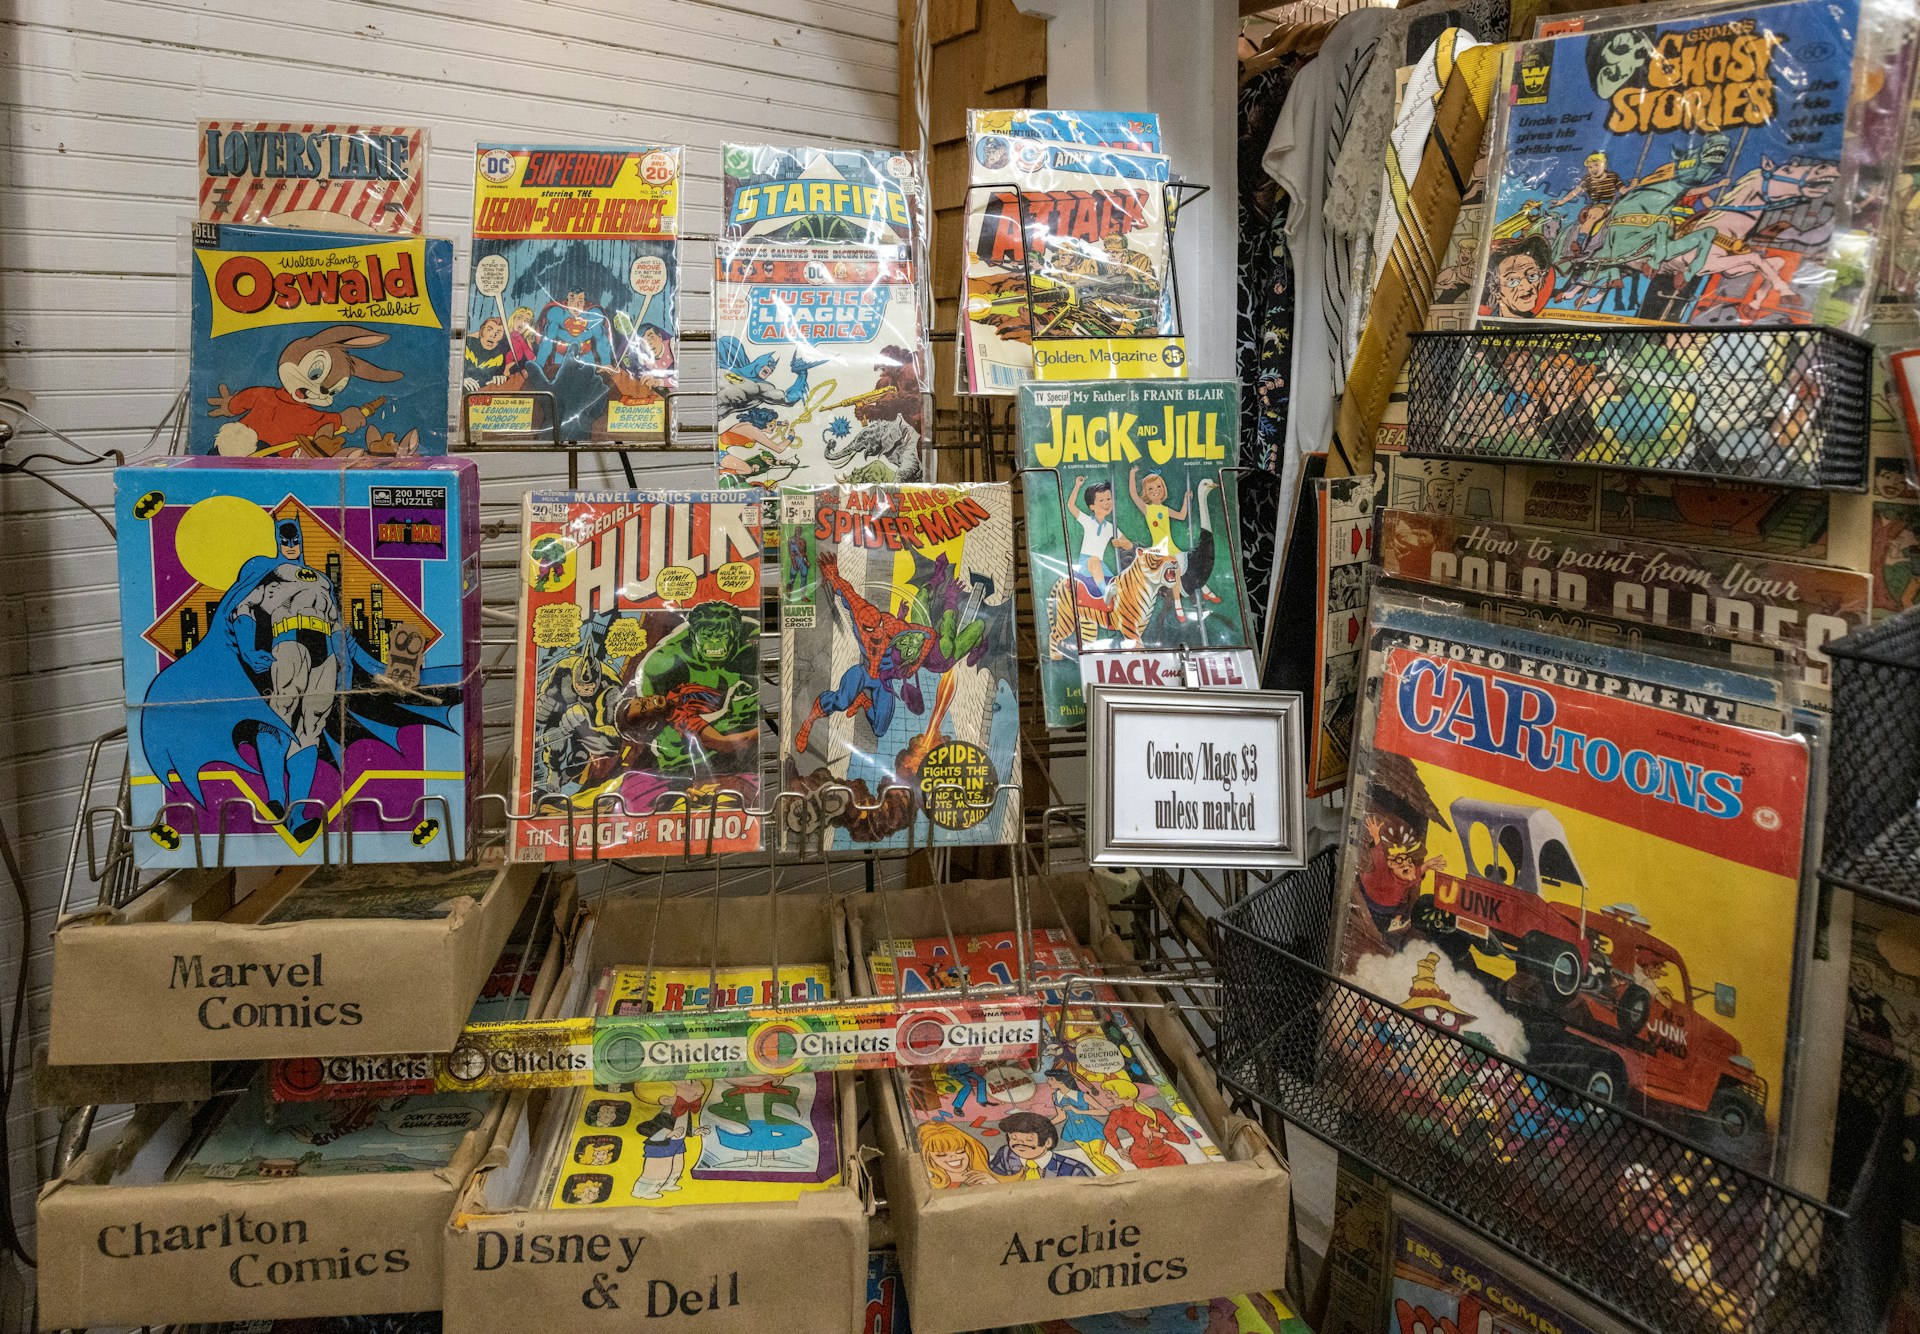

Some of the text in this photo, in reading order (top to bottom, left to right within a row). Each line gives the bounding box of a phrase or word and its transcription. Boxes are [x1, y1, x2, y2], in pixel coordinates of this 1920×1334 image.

[1648, 34, 1783, 88] GHOST
[1608, 80, 1774, 133] STORIES
[1518, 111, 1593, 127] Uncle Bert
[1516, 127, 1577, 144] gives his
[206, 129, 409, 180] LOVERS' LANE
[487, 157, 510, 174] DC
[523, 152, 625, 186] SUPERBOY
[541, 189, 593, 200] starring THE
[735, 182, 910, 225] STARFIRE
[476, 197, 538, 232] LEGION
[542, 199, 668, 233] SUPER-HEROES
[980, 189, 1149, 267] ATTACK
[277, 253, 361, 269] Walter Lantz
[771, 248, 829, 259] SALUTES THE
[214, 252, 419, 314] Oswald
[760, 289, 877, 305] JUSTICE
[338, 303, 421, 319] the Rabbit
[761, 323, 867, 339] AMERICA
[1034, 349, 1086, 367] Golden
[1089, 348, 1158, 367] Magazine
[1035, 393, 1044, 402] TV
[1046, 392, 1069, 403] Special
[1092, 390, 1126, 402] Father
[1130, 389, 1139, 400] Is
[1143, 389, 1184, 401] FRANK
[1187, 388, 1224, 400] BLAIR
[480, 406, 531, 415] LEGIONNAIRE
[619, 414, 654, 422] SECRET
[471, 422, 531, 430] REMEMBERED?
[609, 422, 659, 430] WEAKNESS
[1034, 405, 1225, 468] JACK AND JILL
[395, 489, 444, 498] 200 PIECE
[395, 498, 433, 506] PUZZLE
[575, 491, 747, 503] MARVEL COMICS GROUP
[847, 489, 950, 512] AMAZING
[561, 502, 642, 549] INCREDIBLE
[802, 509, 812, 518] 97
[815, 497, 991, 550] SPIDER-MAN
[577, 502, 760, 624] HULK
[1461, 525, 1519, 557] How
[1526, 536, 1554, 561] to
[1557, 547, 1633, 576] paint
[1641, 551, 1713, 588] from
[722, 580, 748, 588] PAY!!
[783, 606, 815, 617] MARVEL
[387, 629, 424, 687] $18
[1500, 638, 1608, 668] MAETERLINCK'S
[1409, 635, 1736, 720] PHOTO EQUIPMENT
[927, 744, 987, 765] SPIDEY
[1146, 740, 1258, 791] Comics/Mags $3
[923, 766, 989, 777] FIGHTS THE
[1154, 791, 1256, 831] unless marked
[526, 815, 756, 847] THE RAGE RHINO!
[633, 830, 650, 844] THE
[635, 820, 649, 832] OF
[1438, 878, 1502, 924] JUNK
[169, 952, 324, 989] Marvel
[662, 977, 825, 1011] Richie Rich
[198, 995, 363, 1031] Comics
[971, 1010, 1021, 1018] CINNAMON
[947, 1025, 1034, 1046] Chiclets
[1646, 1018, 1689, 1046] JUNK
[648, 1041, 741, 1065] Chiclets
[800, 1034, 890, 1056] Chiclets
[328, 1057, 428, 1082] Chiclets
[490, 1049, 587, 1073] Chiclets
[403, 1113, 433, 1121] DON'T
[97, 1211, 309, 1259] Charlton
[1000, 1219, 1142, 1266] Archie
[473, 1222, 646, 1273] Disney
[229, 1247, 410, 1288] Comics
[1047, 1253, 1188, 1296] Comics
[1404, 1237, 1482, 1292] TRS-80
[581, 1272, 741, 1318] & Dell
